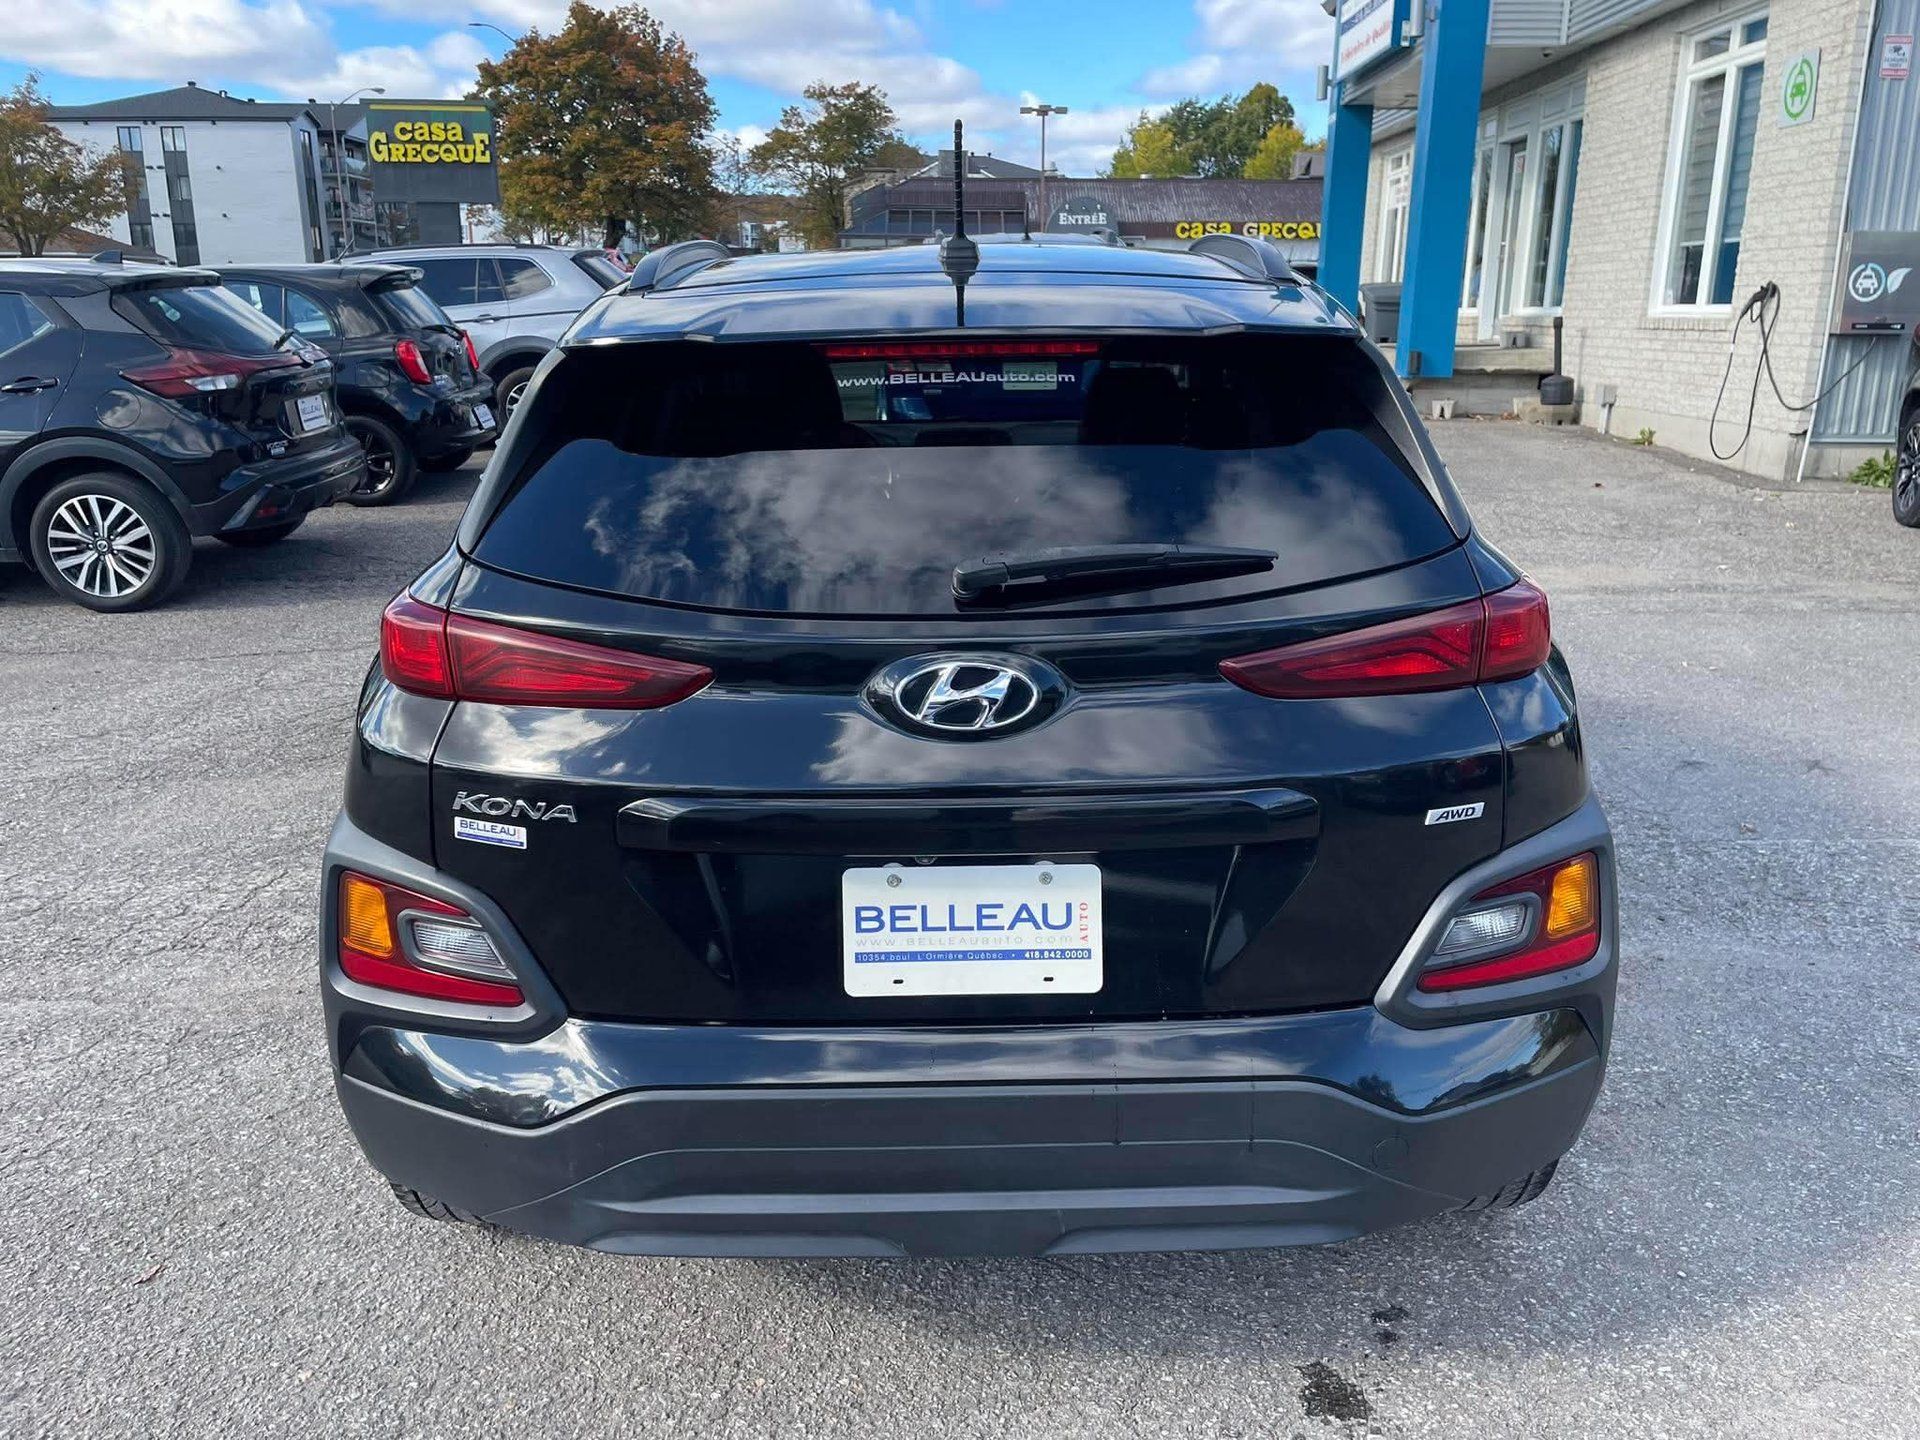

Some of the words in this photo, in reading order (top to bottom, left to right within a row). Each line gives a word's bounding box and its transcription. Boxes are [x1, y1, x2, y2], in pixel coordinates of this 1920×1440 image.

[369, 131, 491, 163] GRECQUE
[1058, 212, 1107, 225] ENTRÉE
[837, 371, 1076, 388] www.BELLEAUauto.com
[452, 791, 578, 823] KONA
[1435, 807, 1476, 822] AWD
[459, 819, 517, 837] BELLEAU
[855, 902, 1073, 934] BELLEAU
[1079, 902, 1089, 942] AUTO
